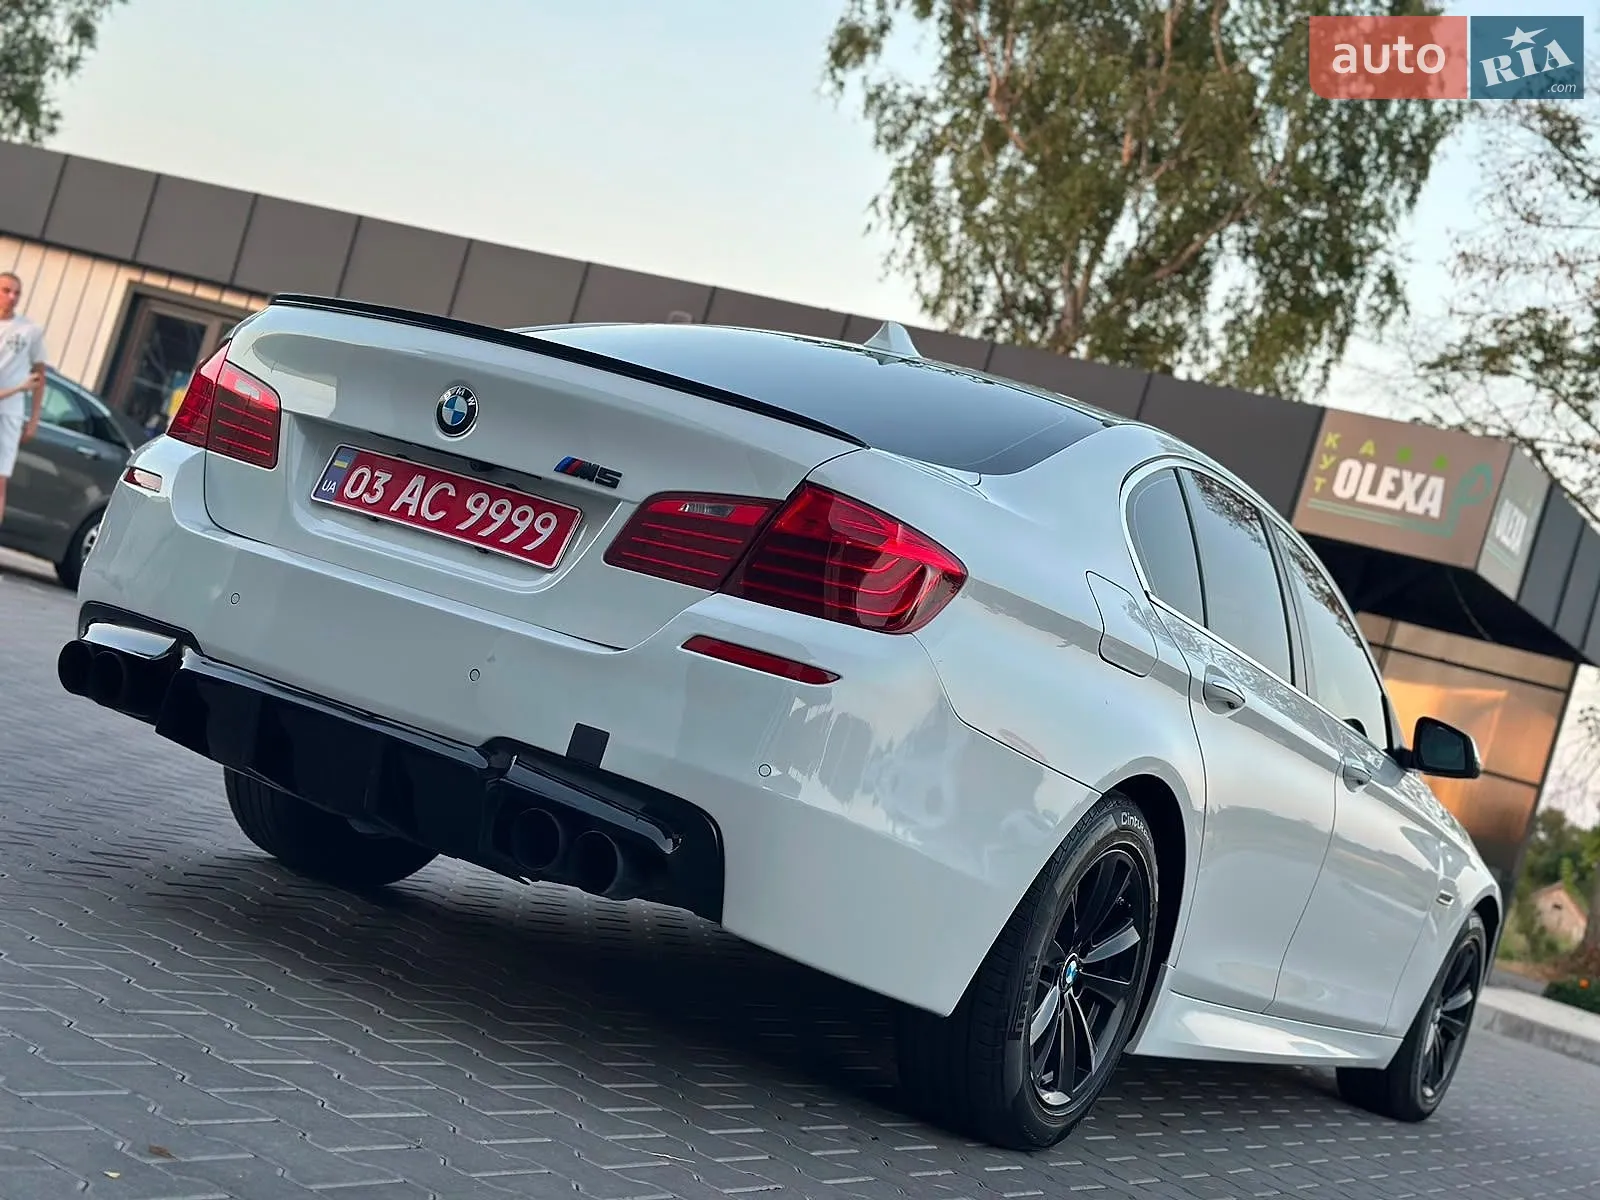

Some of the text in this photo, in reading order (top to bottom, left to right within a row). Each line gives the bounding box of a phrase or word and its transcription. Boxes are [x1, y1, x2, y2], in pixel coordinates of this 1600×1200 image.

[320, 479, 337, 494] UA
[343, 466, 558, 551] 03 AC 9999
[1332, 458, 1446, 520] OLEXA
